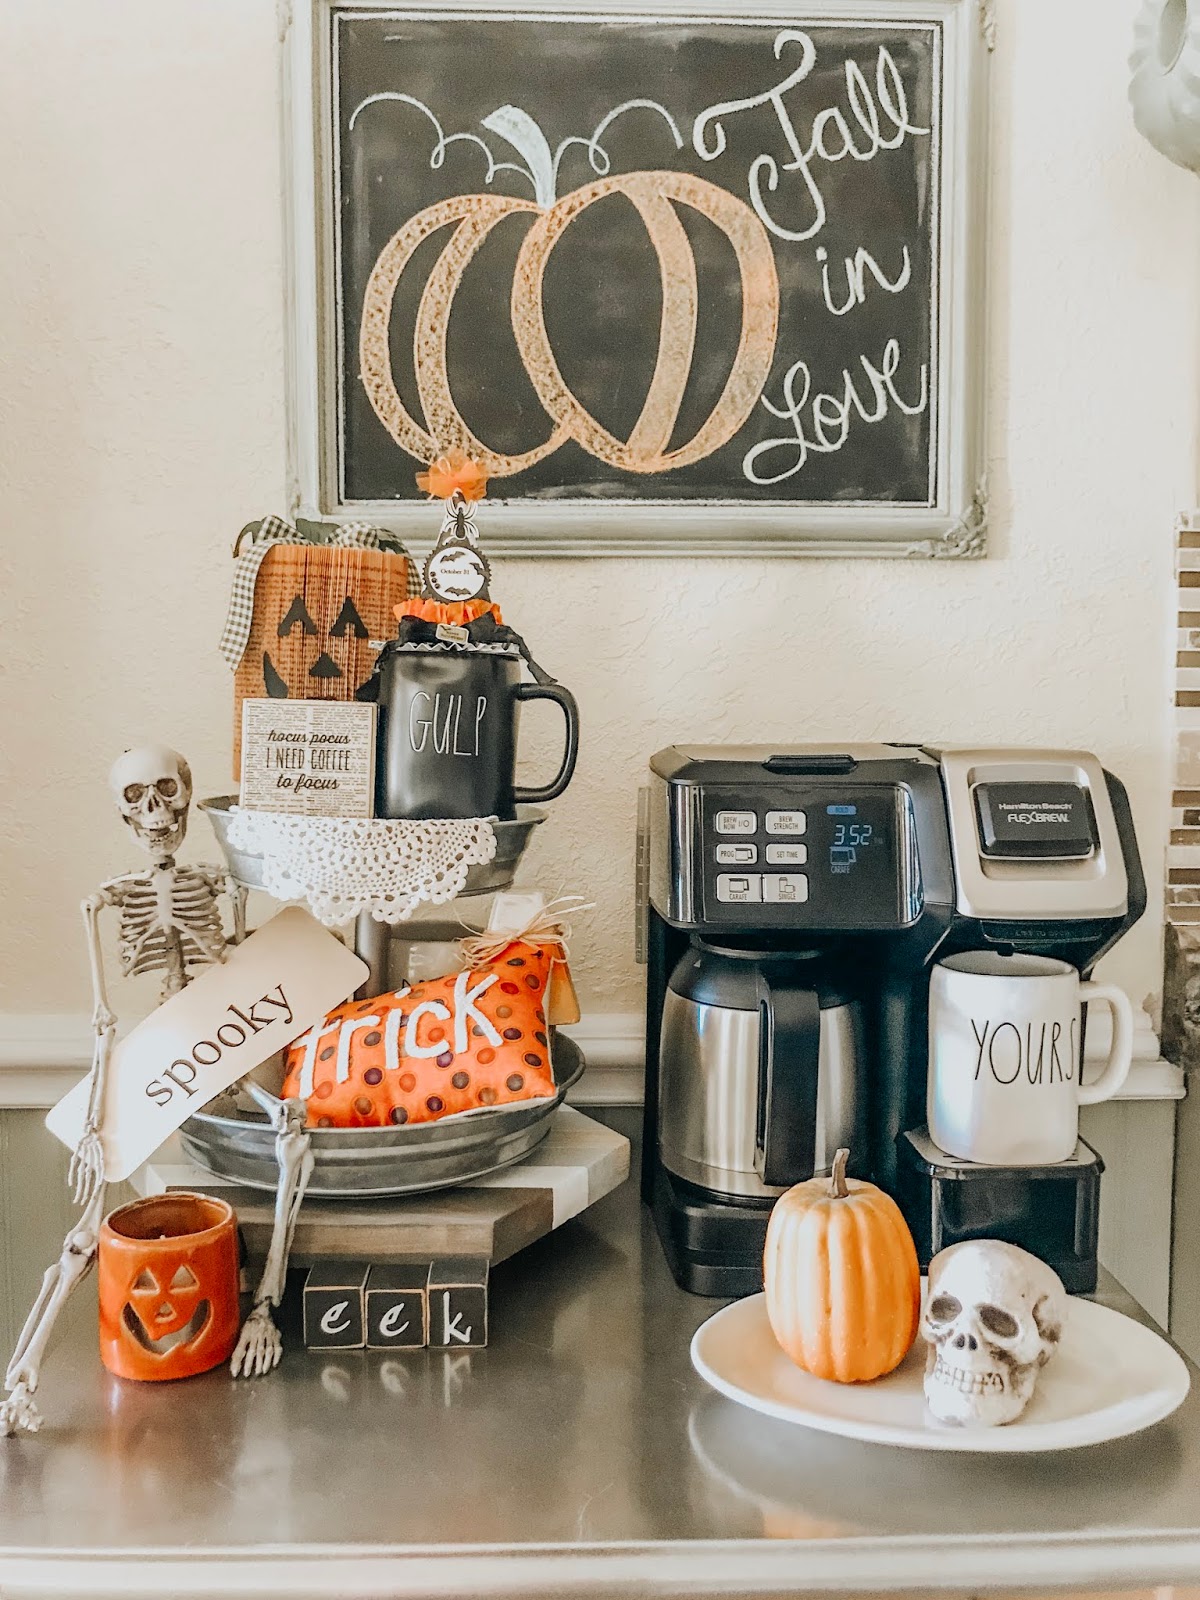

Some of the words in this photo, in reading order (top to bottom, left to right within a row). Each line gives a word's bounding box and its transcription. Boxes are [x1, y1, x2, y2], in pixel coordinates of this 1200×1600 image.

[693, 29, 930, 241] Fall
[816, 246, 911, 315] in
[742, 338, 927, 485] Love
[409, 691, 487, 757] GULP
[267, 729, 307, 743] hocus
[309, 734, 351, 746] pocus
[266, 747, 270, 768] I
[276, 748, 305, 769] NEED
[310, 749, 351, 771] COFFEE
[276, 773, 293, 788] to
[294, 773, 340, 793] focus
[773, 822, 799, 830] STRENGTH
[1007, 811, 1070, 824] FLEXBREW
[720, 850, 735, 858] PROG
[776, 850, 785, 858] SET
[786, 850, 798, 858] TIME
[728, 893, 747, 901] CARAFE
[778, 893, 796, 901] SINGLE
[145, 983, 293, 1107] spooky
[970, 1018, 1076, 1084] YOURS
[320, 1291, 472, 1345] eek
